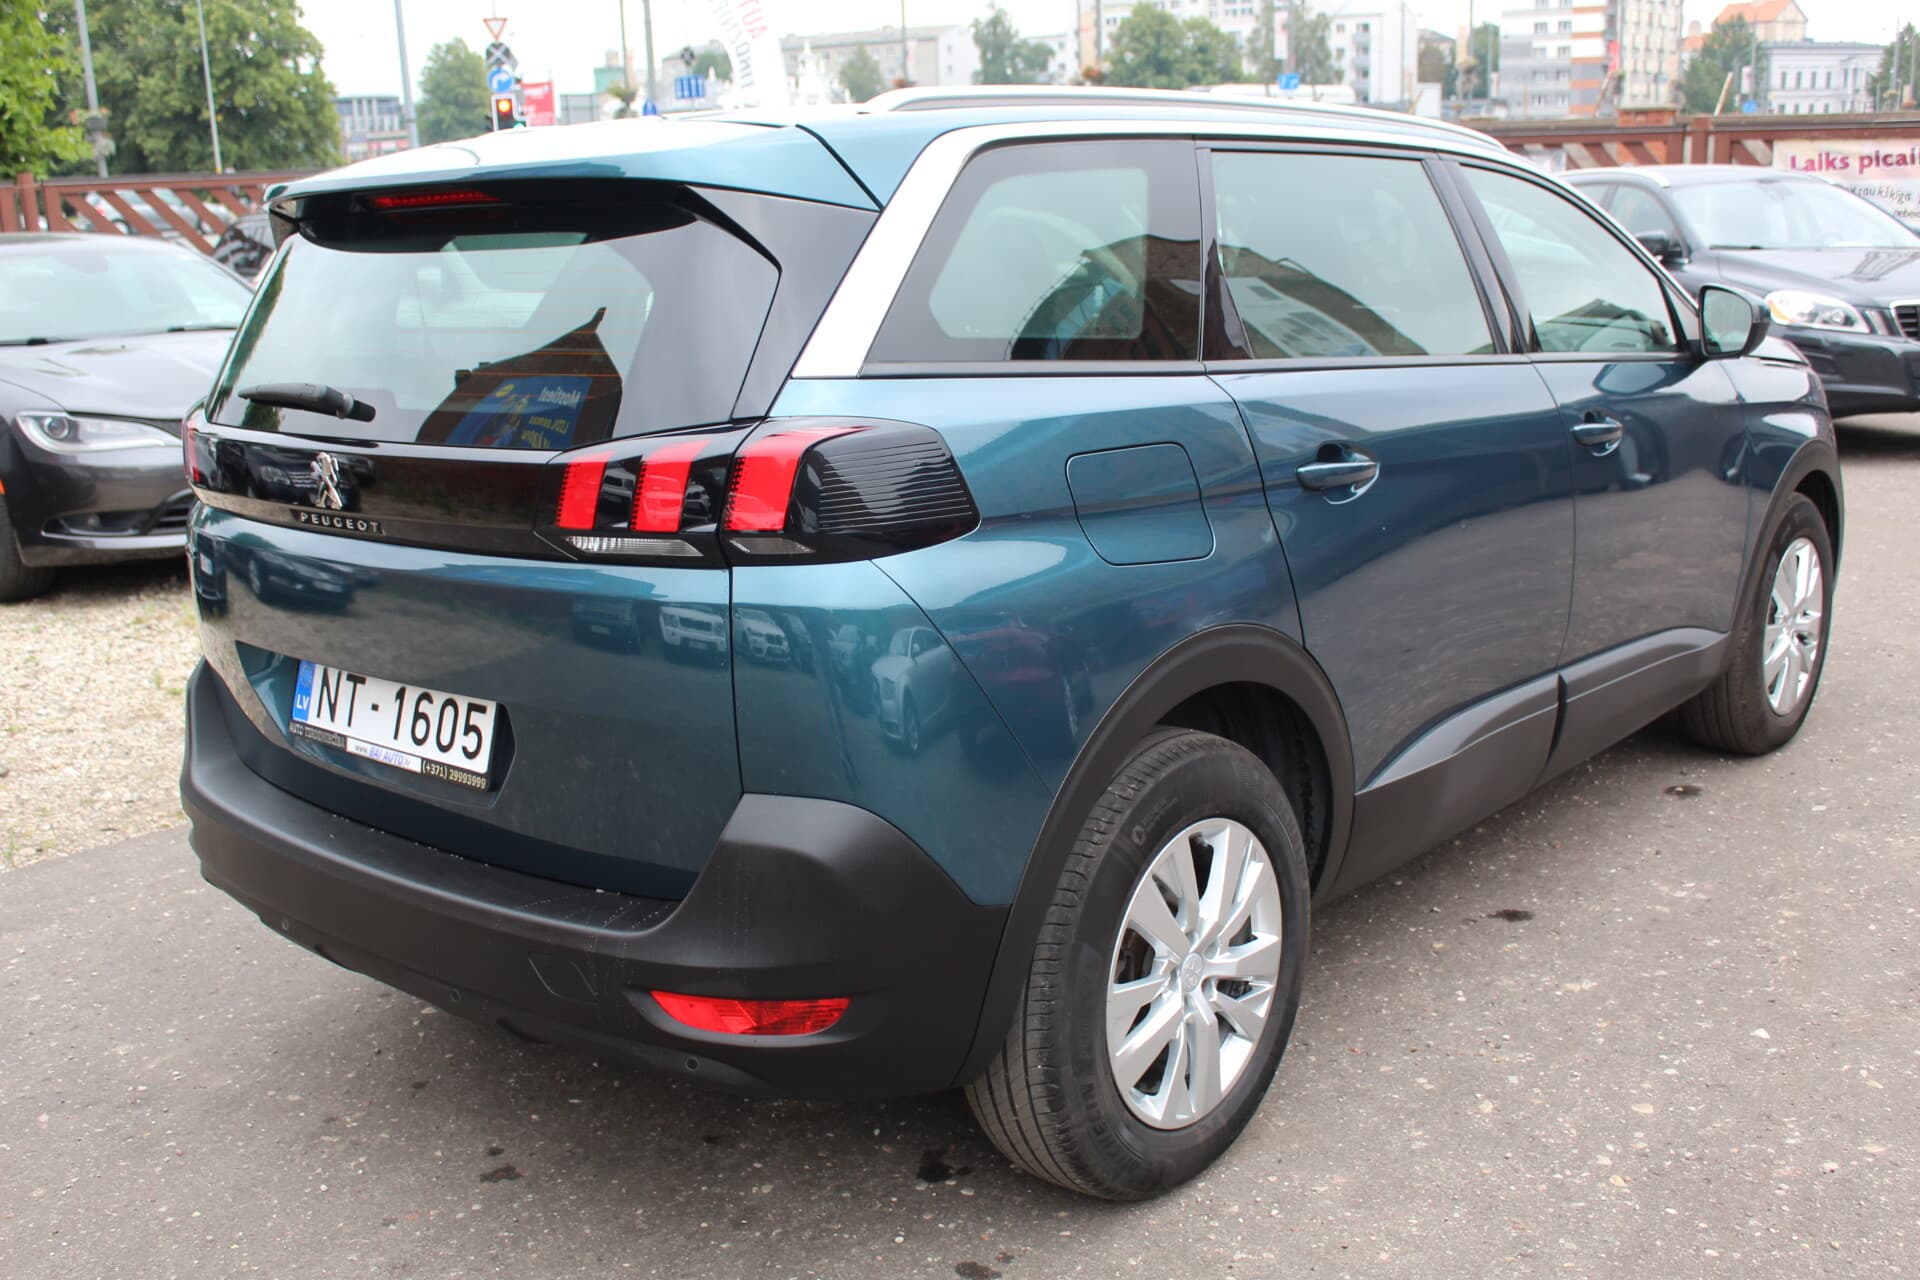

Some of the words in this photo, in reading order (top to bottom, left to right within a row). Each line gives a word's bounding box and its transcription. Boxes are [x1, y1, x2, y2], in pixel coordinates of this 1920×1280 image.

[1790, 152, 1850, 172] Laiks
[300, 511, 379, 533] PEUGEOT
[296, 693, 311, 709] LV
[422, 760, 448, 780] (+371)
